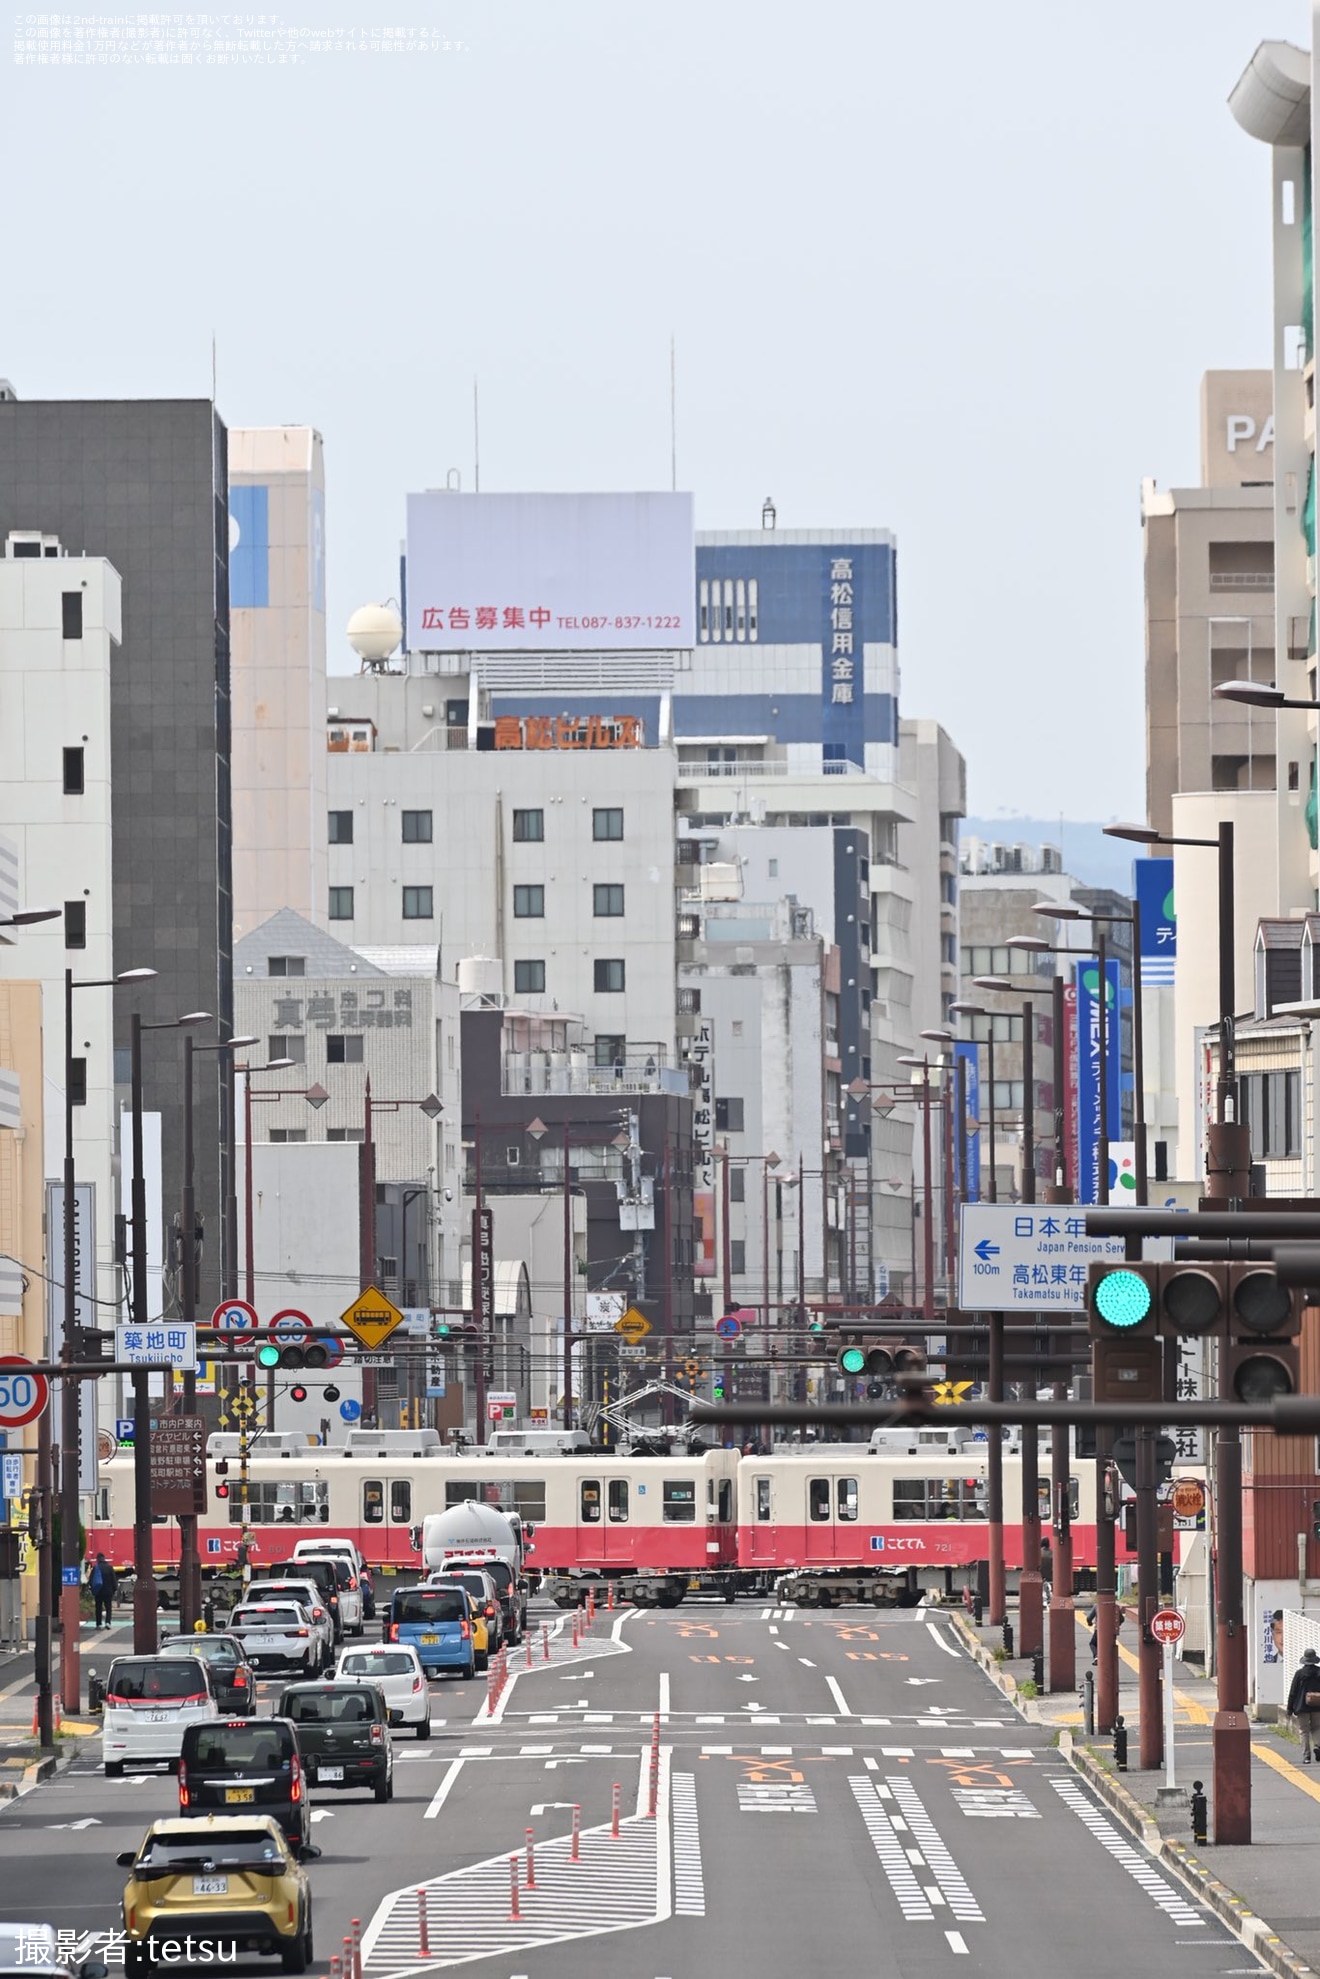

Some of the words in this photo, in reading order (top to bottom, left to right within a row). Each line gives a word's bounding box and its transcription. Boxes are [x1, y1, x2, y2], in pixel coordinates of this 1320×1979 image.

[421, 606, 552, 630] 広告募集中
[830, 557, 855, 705] 高松信用金庫
[1037, 1241, 1065, 1255] Japan
[1067, 1241, 1102, 1253] Pension
[973, 1263, 1000, 1276] 100m
[1013, 1288, 1061, 1300] Takamatsu
[124, 1331, 187, 1350] 築地町
[489, 1404, 501, 1419] P
[119, 1421, 134, 1438] P
[159, 1418, 202, 1429] 市内P案内
[1176, 1492, 1202, 1507] 消火栓
[223, 1540, 261, 1552] ことん
[1155, 1620, 1182, 1631] 築地町
